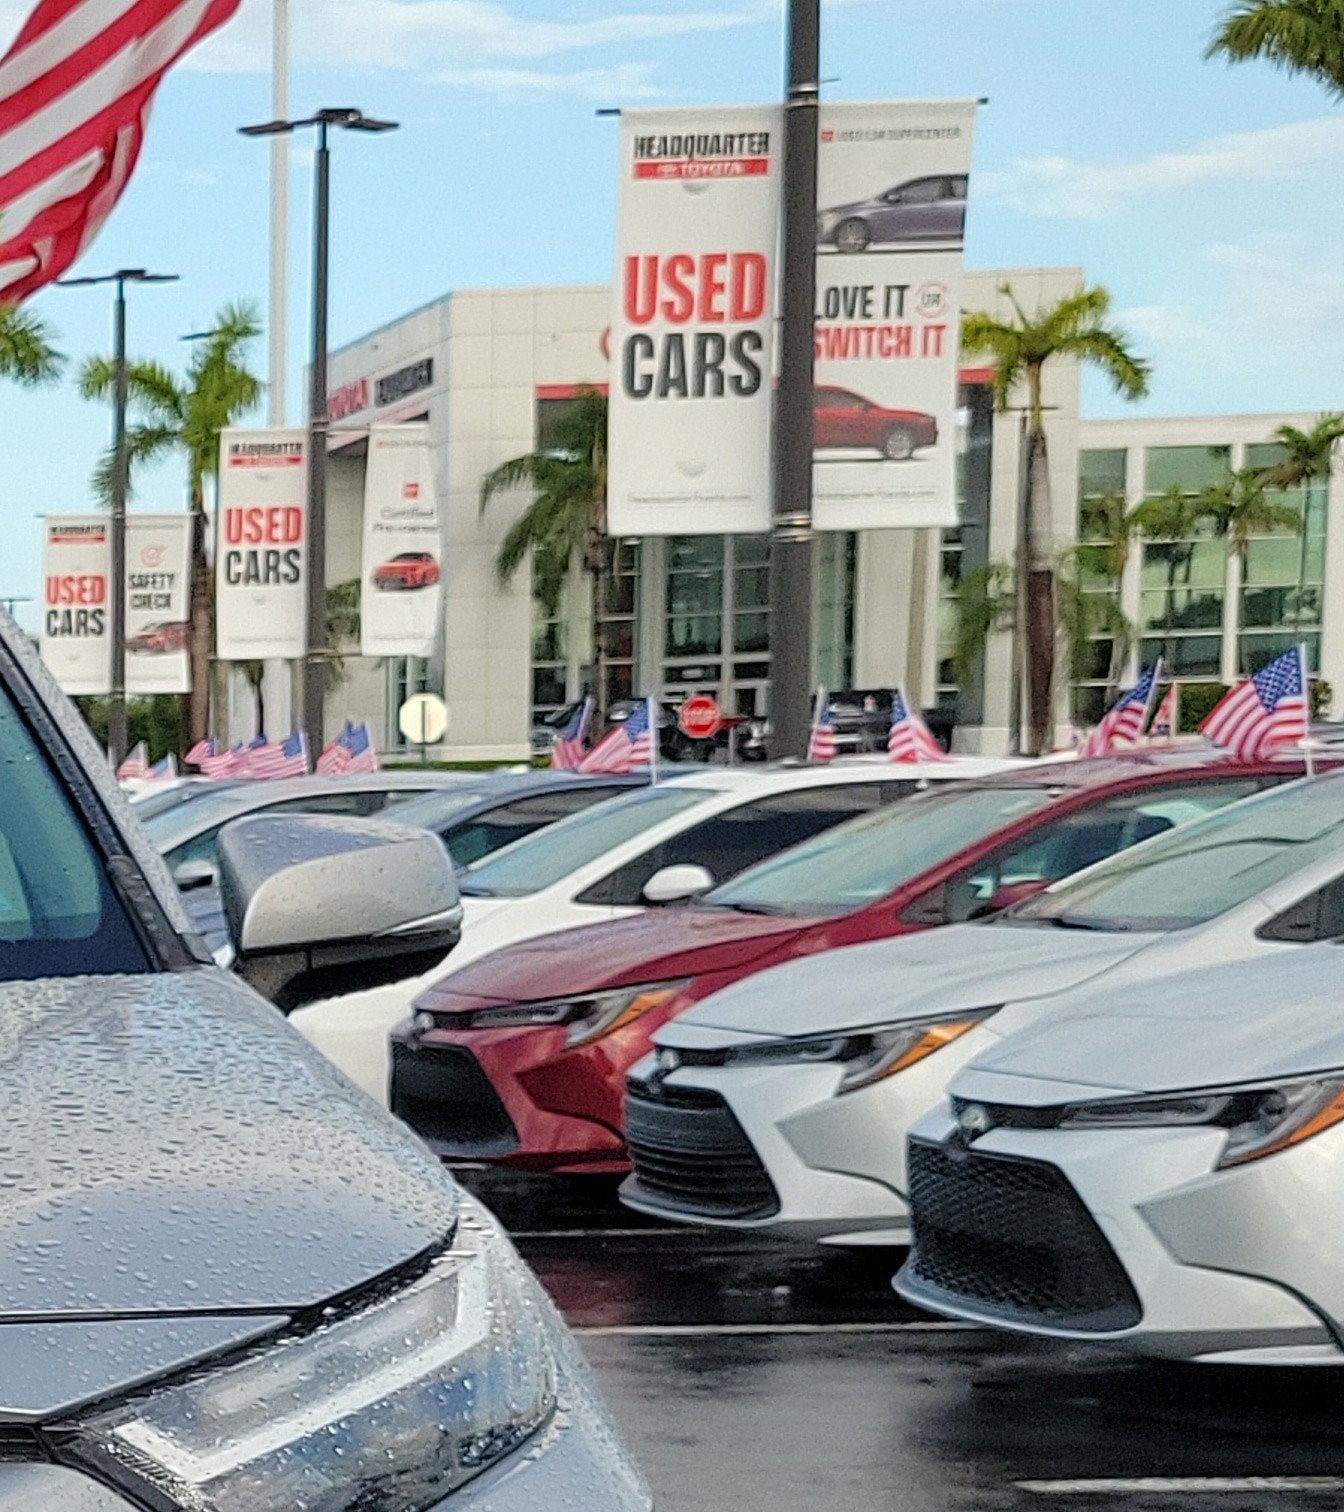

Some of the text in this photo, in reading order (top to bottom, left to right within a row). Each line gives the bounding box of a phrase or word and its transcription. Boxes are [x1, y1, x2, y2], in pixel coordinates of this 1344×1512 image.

[633, 132, 770, 161] HEADQUARTER
[623, 251, 768, 325] USED
[884, 284, 910, 318] IT
[815, 324, 946, 359] SWITCH IT
[623, 330, 765, 401] CARS
[226, 506, 302, 545] USED
[226, 549, 302, 586] CARS
[46, 574, 106, 605] USED
[46, 608, 105, 637] CARS
